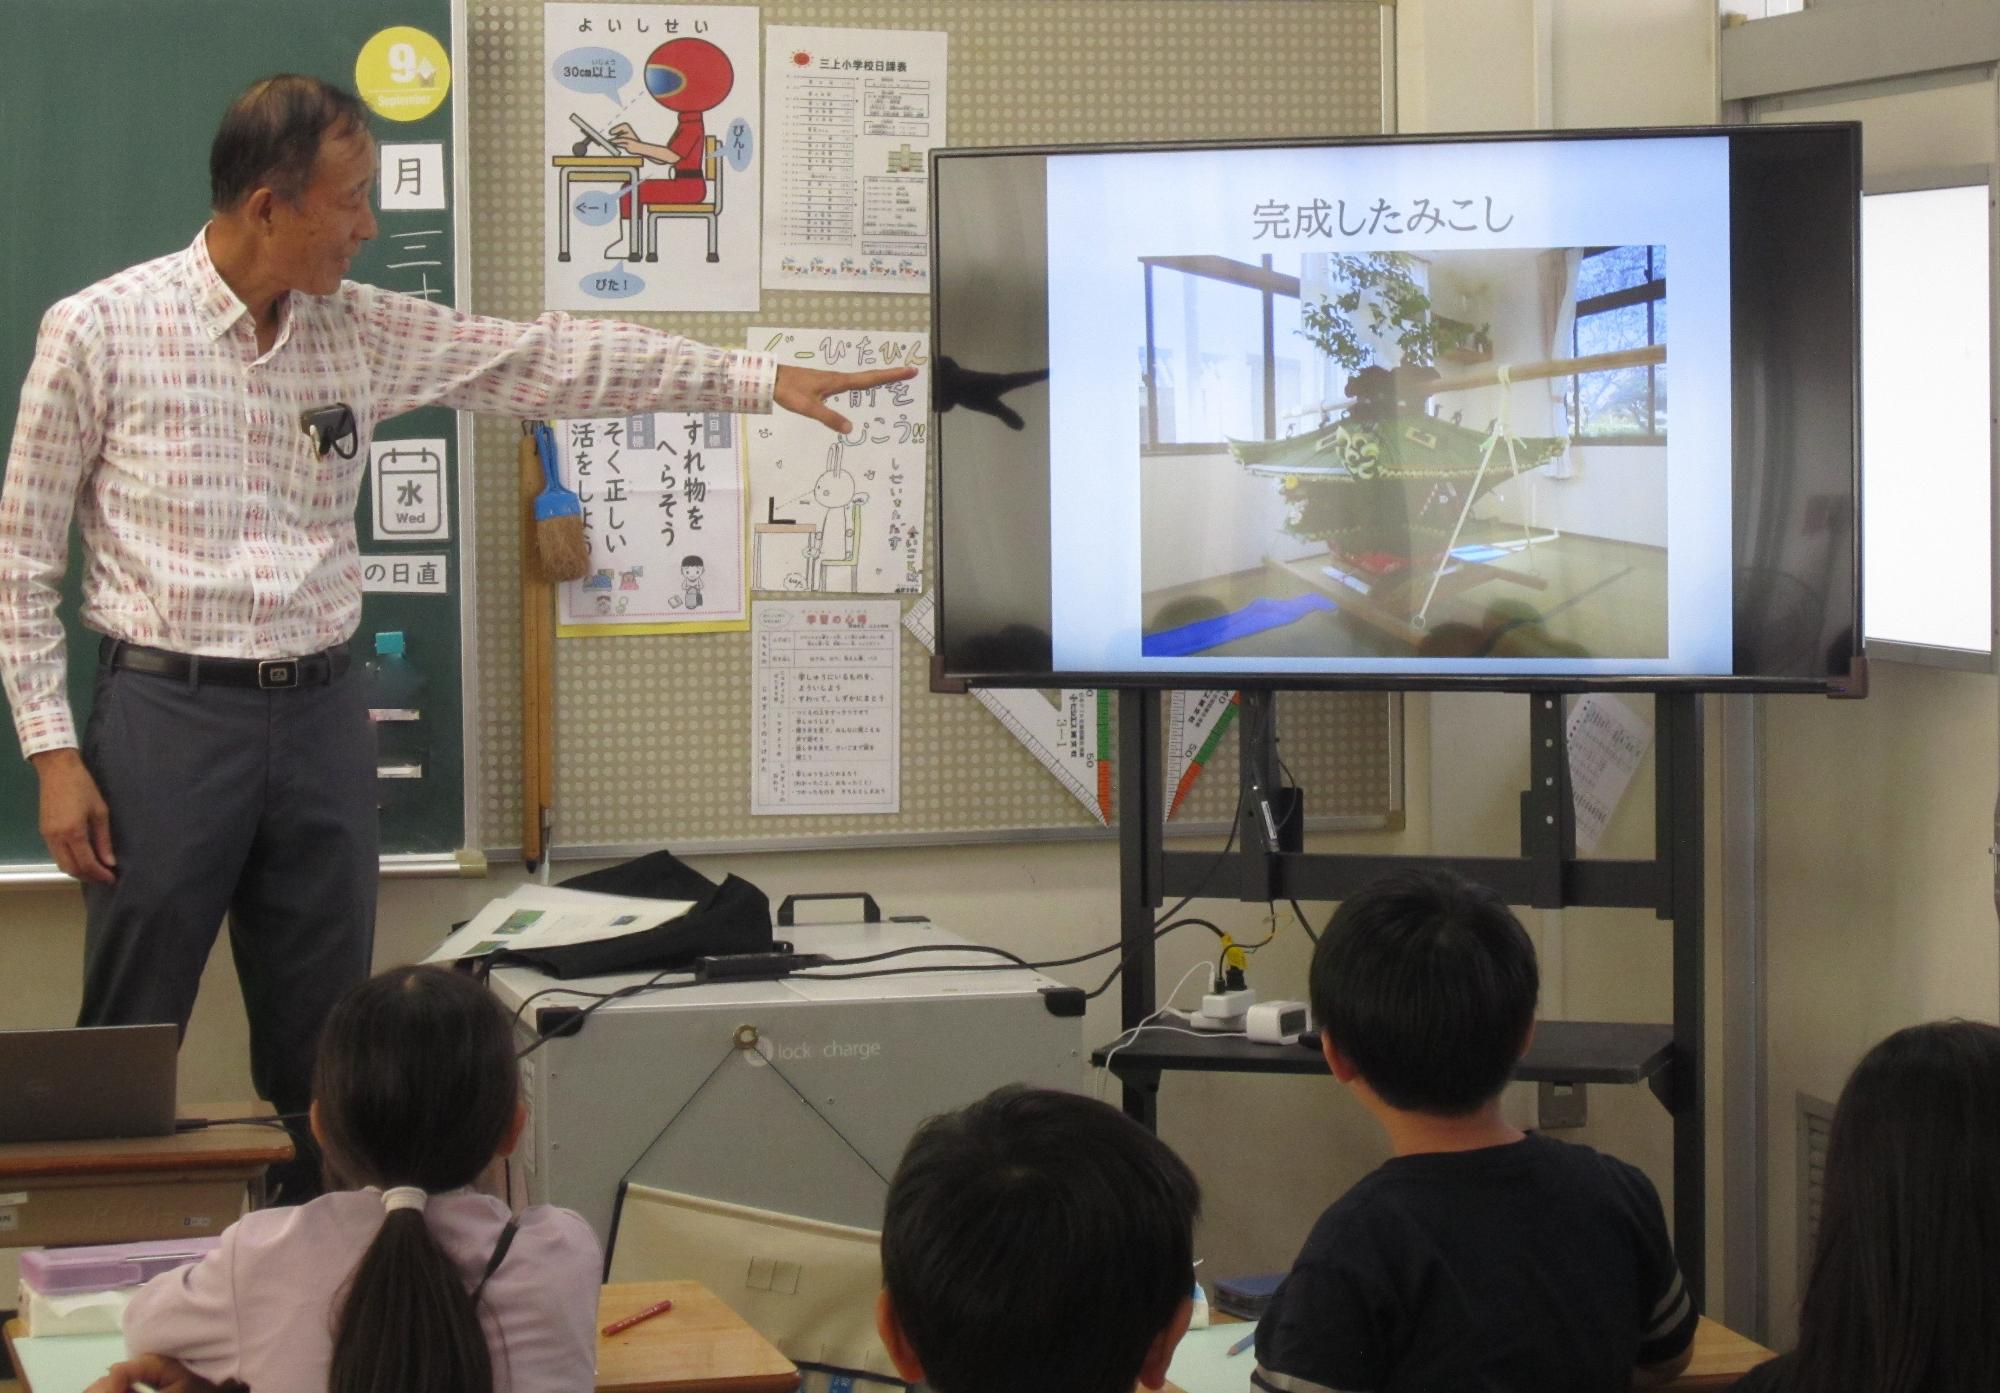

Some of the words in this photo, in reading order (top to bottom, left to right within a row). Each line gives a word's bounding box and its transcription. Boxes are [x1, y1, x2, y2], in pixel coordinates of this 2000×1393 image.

[579, 17, 708, 33] よいしせい
[388, 42, 416, 83] 9
[819, 57, 907, 73] 三上小学校日課表
[378, 93, 432, 107] September
[394, 157, 421, 195] 月
[1252, 196, 1514, 240] 完成したみこし
[683, 413, 706, 530] すれ物を
[397, 480, 423, 507] 水
[604, 422, 627, 553] そく正しい
[657, 440, 677, 547] へらそう
[396, 512, 425, 524] Wed
[364, 562, 439, 585] の日直
[823, 1040, 881, 1061] charge
